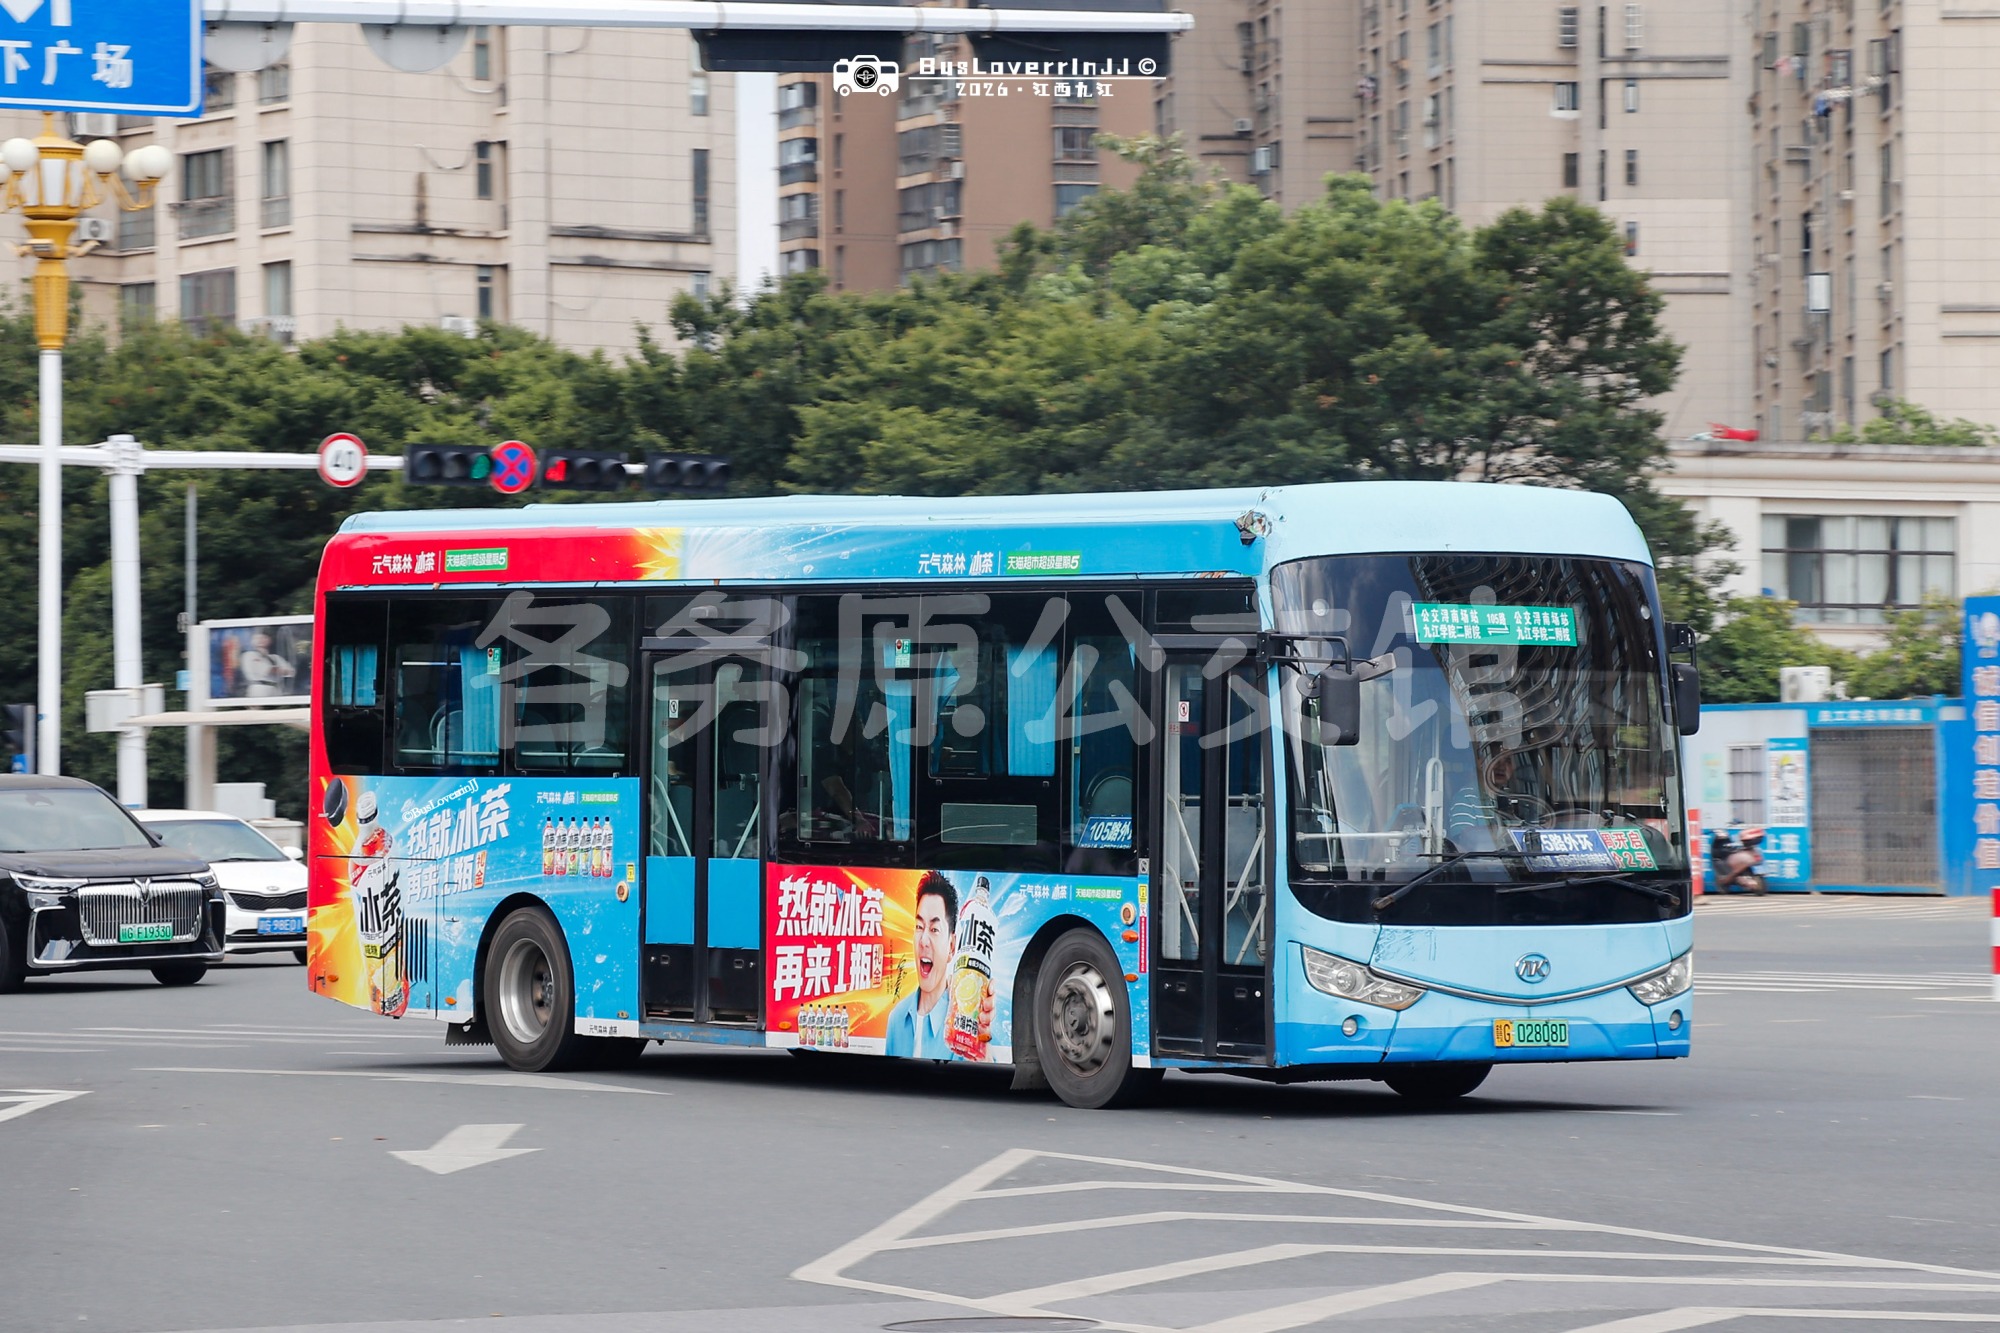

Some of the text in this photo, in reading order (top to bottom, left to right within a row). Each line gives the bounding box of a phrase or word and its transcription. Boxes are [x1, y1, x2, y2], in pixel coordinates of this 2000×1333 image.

[372, 554, 412, 574] 元气森林
[918, 553, 966, 575] 元气森林
[1007, 555, 1080, 570] 天猫超市超级星期5
[1421, 609, 1479, 624] 公交浔南场站
[1514, 611, 1569, 626] 公交浔南场站
[1423, 624, 1481, 640] 九江学院二附院
[1516, 626, 1571, 642] 九江学院二附院
[1090, 821, 1132, 842] 105路外
[1523, 833, 1594, 851] 5路外环
[1019, 885, 1049, 898] 元气森林
[775, 873, 884, 936] 热就冰茶
[773, 940, 872, 1002] 再来1瓶
